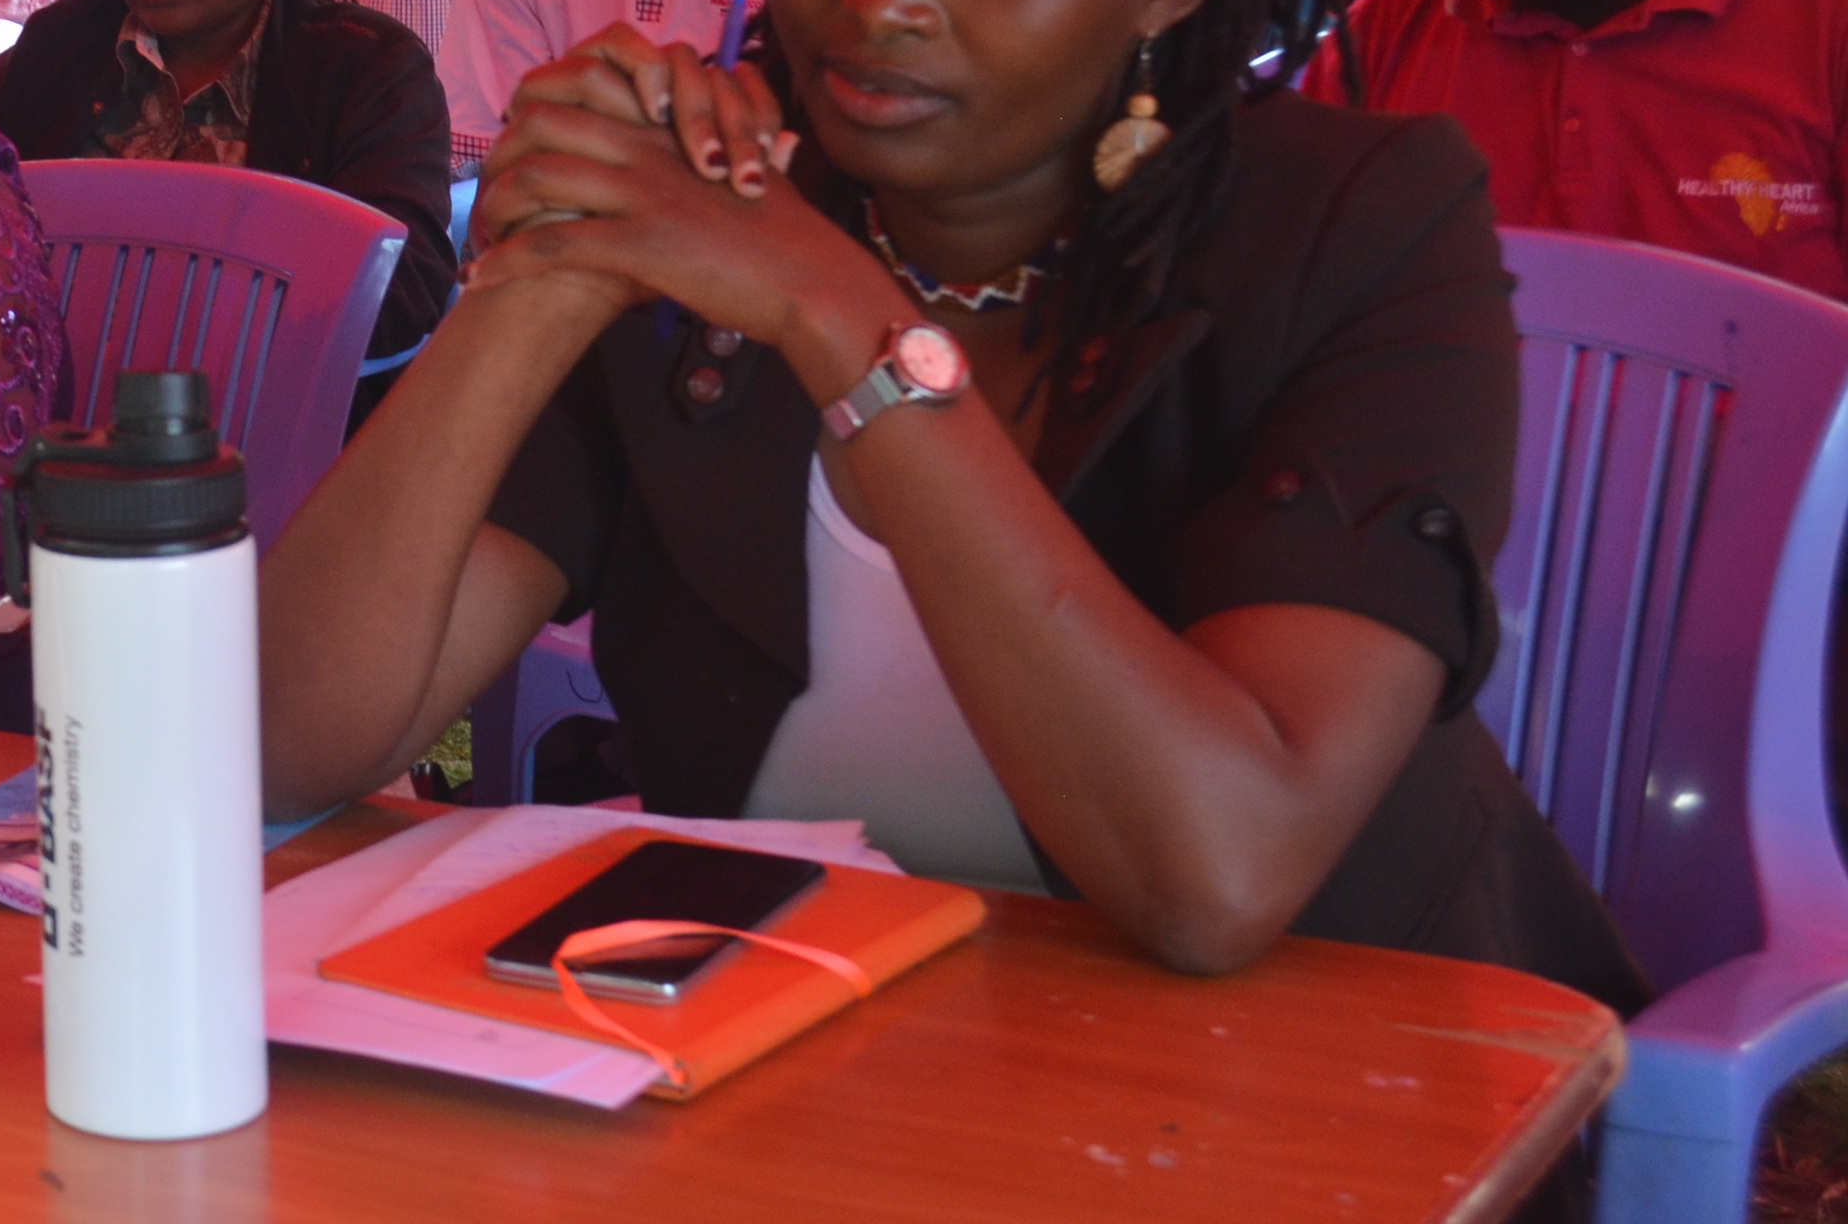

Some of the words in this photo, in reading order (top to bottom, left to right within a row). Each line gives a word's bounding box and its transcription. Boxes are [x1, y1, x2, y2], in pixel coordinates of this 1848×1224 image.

[1677, 177, 1754, 197] HEALTHY
[1759, 182, 1816, 200] HEART
[64, 715, 82, 834] chemistry
[67, 840, 83, 914] create
[68, 919, 84, 957] We
